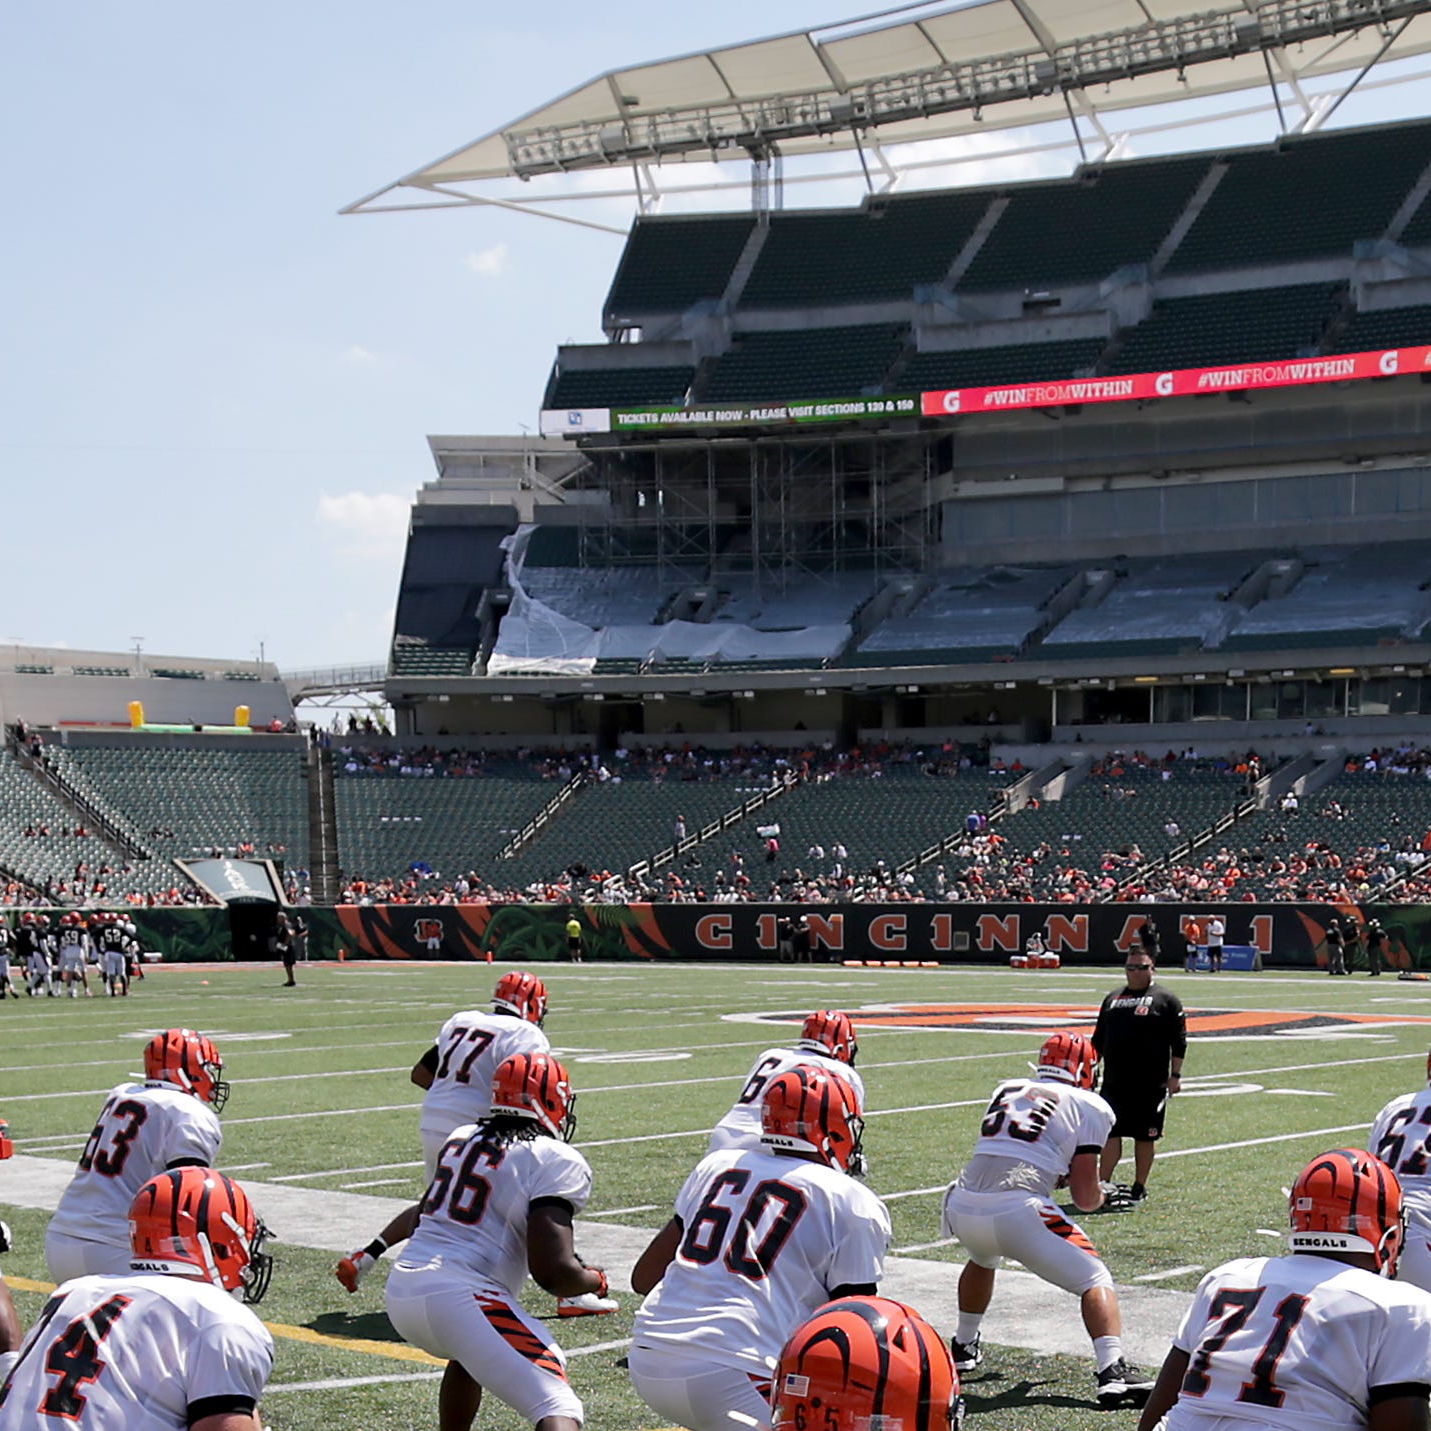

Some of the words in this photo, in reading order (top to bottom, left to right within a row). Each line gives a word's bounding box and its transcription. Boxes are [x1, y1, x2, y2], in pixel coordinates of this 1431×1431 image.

[618, 413, 658, 425] TICKETS
[660, 411, 714, 424] AVAILABLE
[716, 410, 742, 421] NOW
[750, 407, 787, 420] PLEASE
[788, 405, 814, 418] VISIT
[815, 402, 865, 416] SECTIONS
[437, 1026, 497, 1084] 77
[416, 1136, 507, 1226] 66
[680, 1168, 808, 1282] 60
[1293, 1237, 1348, 1249] BENGALS
[1181, 1285, 1312, 1409] 71
